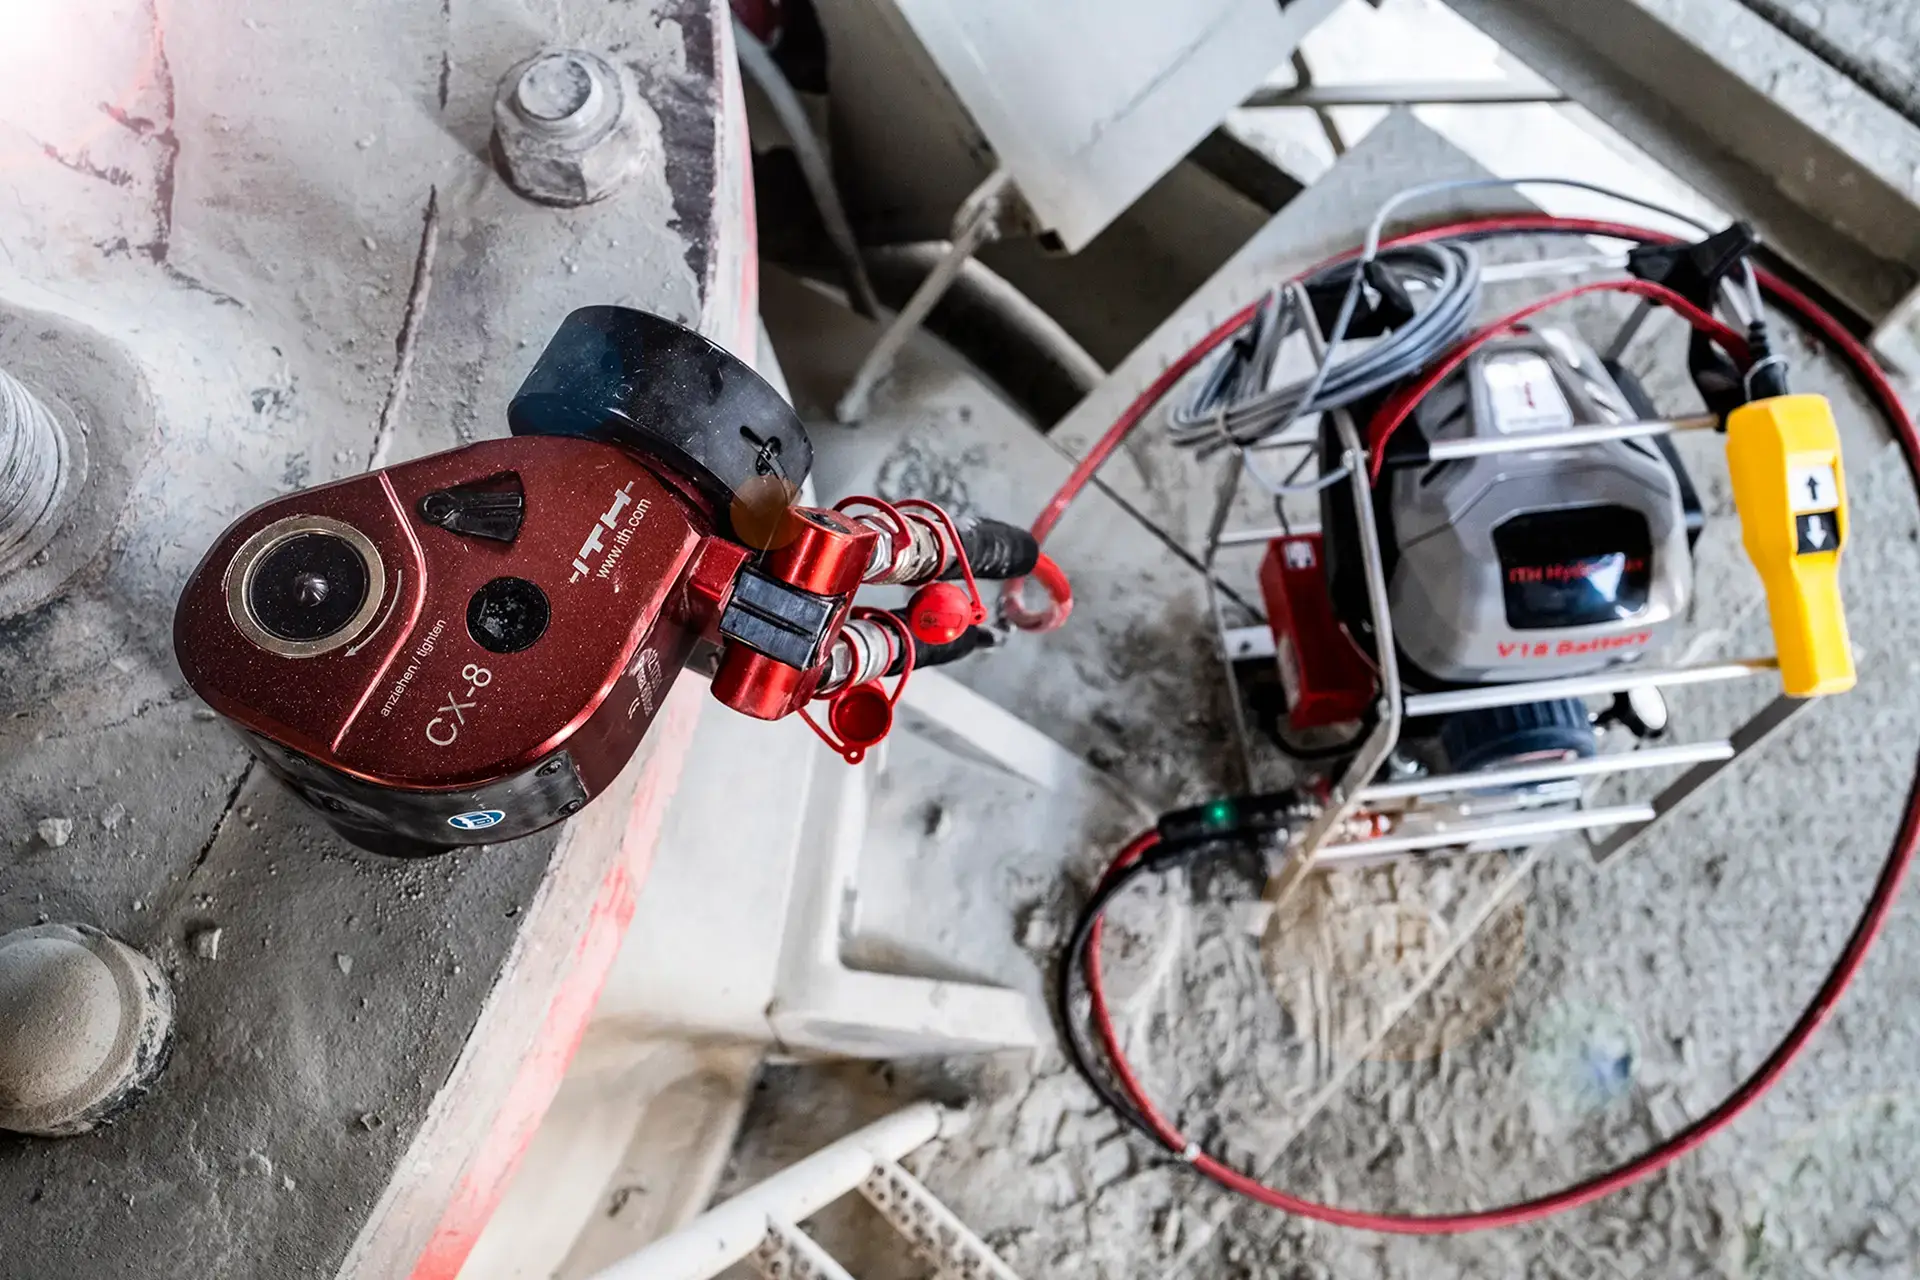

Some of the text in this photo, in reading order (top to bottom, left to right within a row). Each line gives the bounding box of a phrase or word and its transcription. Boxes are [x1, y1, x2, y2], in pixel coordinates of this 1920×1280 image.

[596, 497, 652, 579] www.ith.com
[380, 664, 417, 717] anziehen
[416, 618, 447, 657] tighten
[1556, 629, 1654, 656] Battery
[425, 662, 493, 747] CX-8
